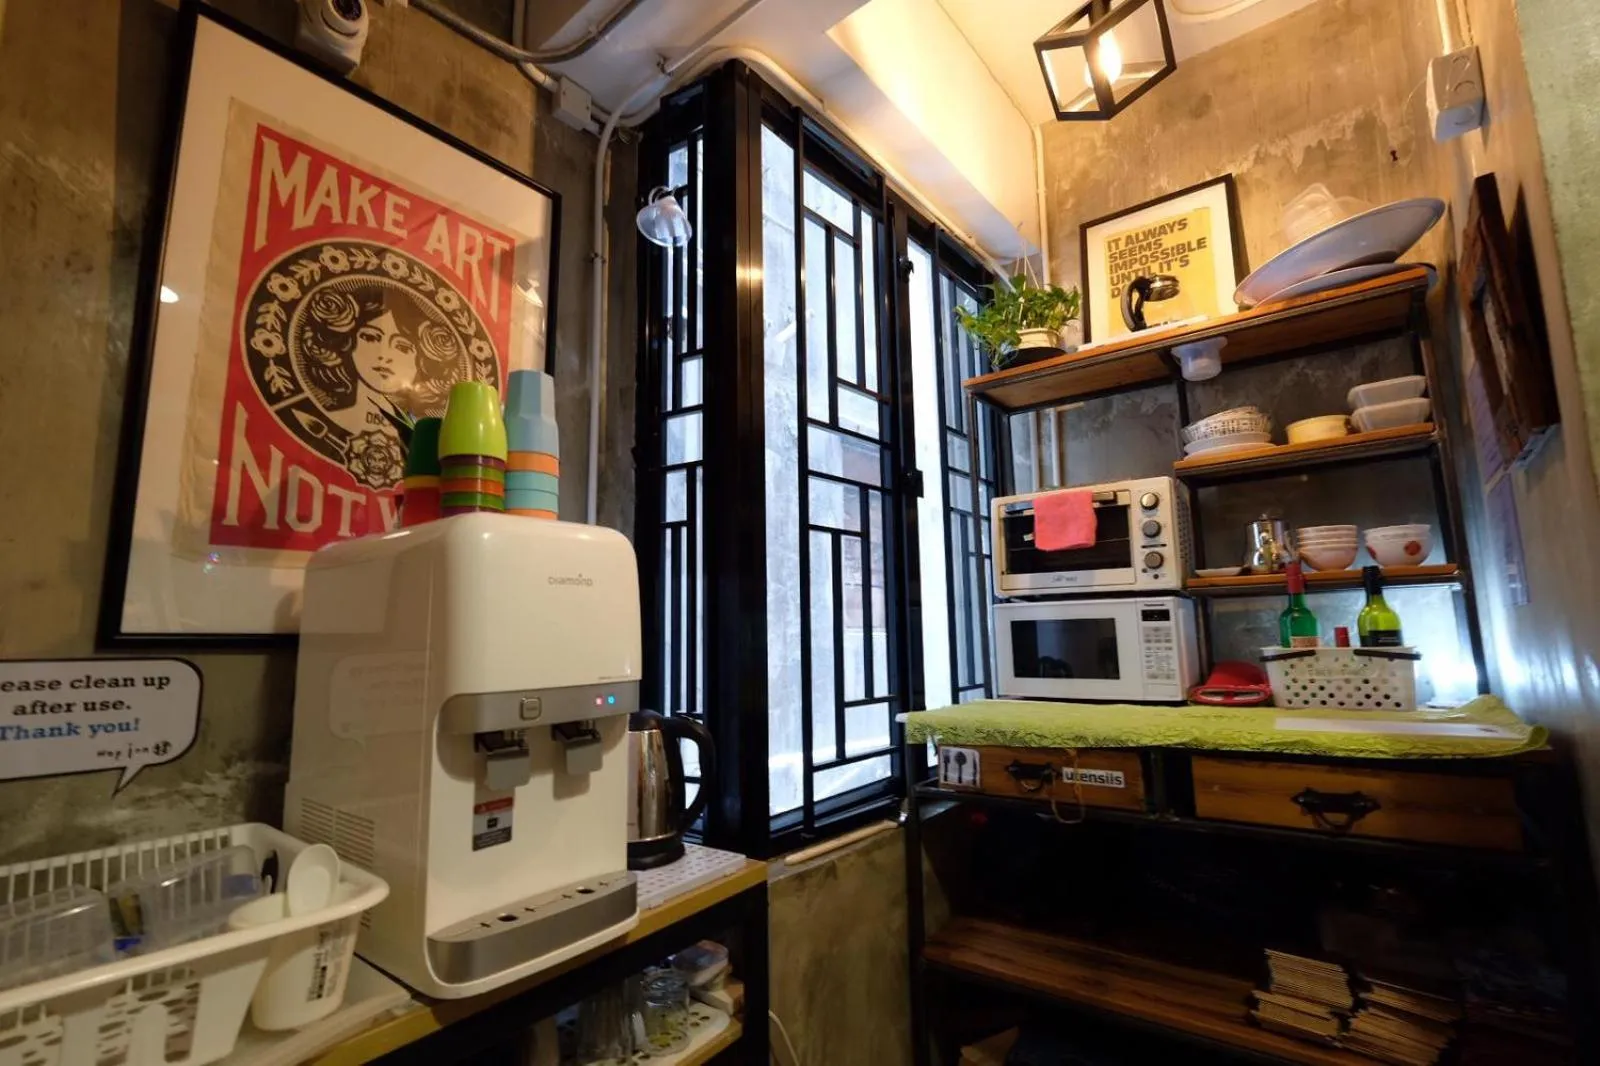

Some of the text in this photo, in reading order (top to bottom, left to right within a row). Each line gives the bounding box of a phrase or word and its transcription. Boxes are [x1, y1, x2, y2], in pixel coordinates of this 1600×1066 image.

[255, 135, 510, 323] MAKE ART
[1107, 218, 1188, 252] IT ALWAYS
[1108, 239, 1163, 263] SEEMS
[1109, 237, 1208, 275] IMPOSSIBLE
[1110, 254, 1190, 287] UNTIL IT'S
[222, 400, 367, 537] NOT
[69, 674, 136, 690] clean
[142, 675, 171, 691] up
[12, 699, 132, 716] after use.
[0, 718, 140, 741] Thank you!
